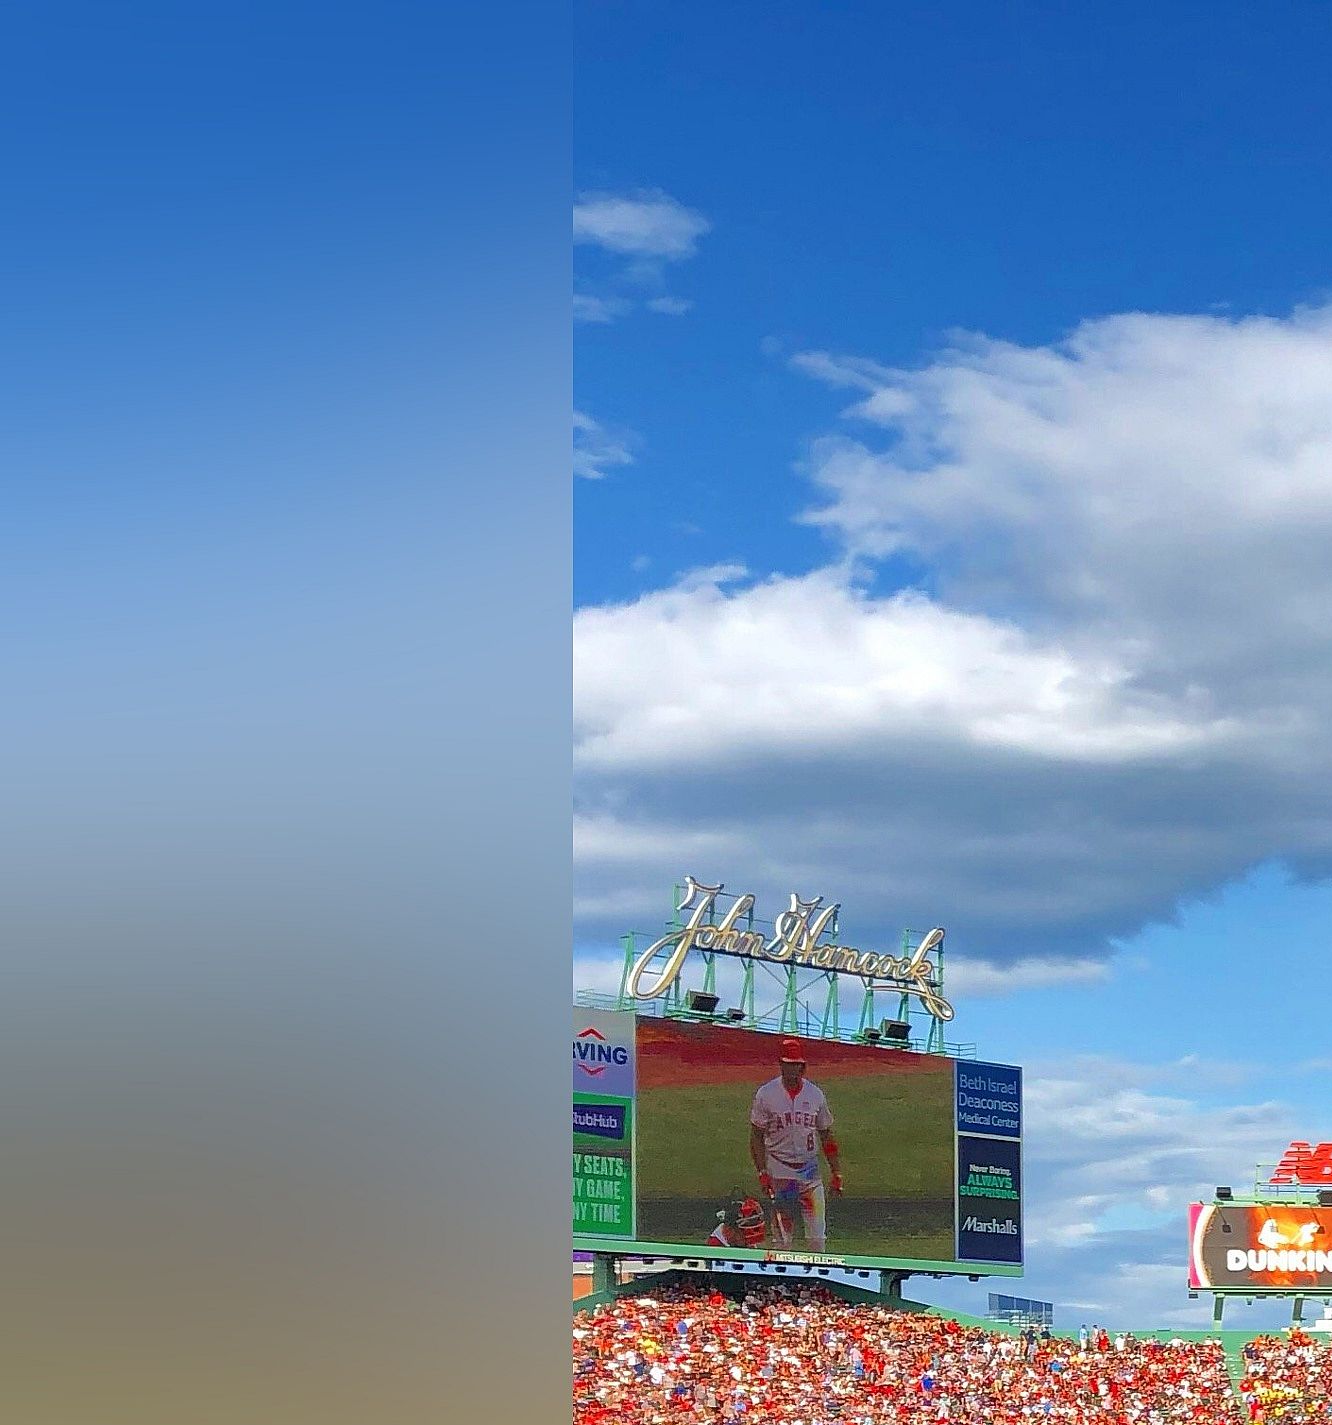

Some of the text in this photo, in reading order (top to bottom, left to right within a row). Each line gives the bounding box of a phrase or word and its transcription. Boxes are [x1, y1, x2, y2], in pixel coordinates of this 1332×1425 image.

[626, 876, 954, 1021] John Hancock
[960, 1074, 1017, 1095] Beth Israel
[959, 1092, 1018, 1112] Deaconess
[959, 1112, 1019, 1129] Medical Center
[584, 1156, 627, 1178] SEATS,
[586, 1178, 625, 1200] GAME,
[967, 1173, 1013, 1188] ALWAYS
[592, 1203, 621, 1224] TIME
[962, 1216, 1018, 1235] Marshalls
